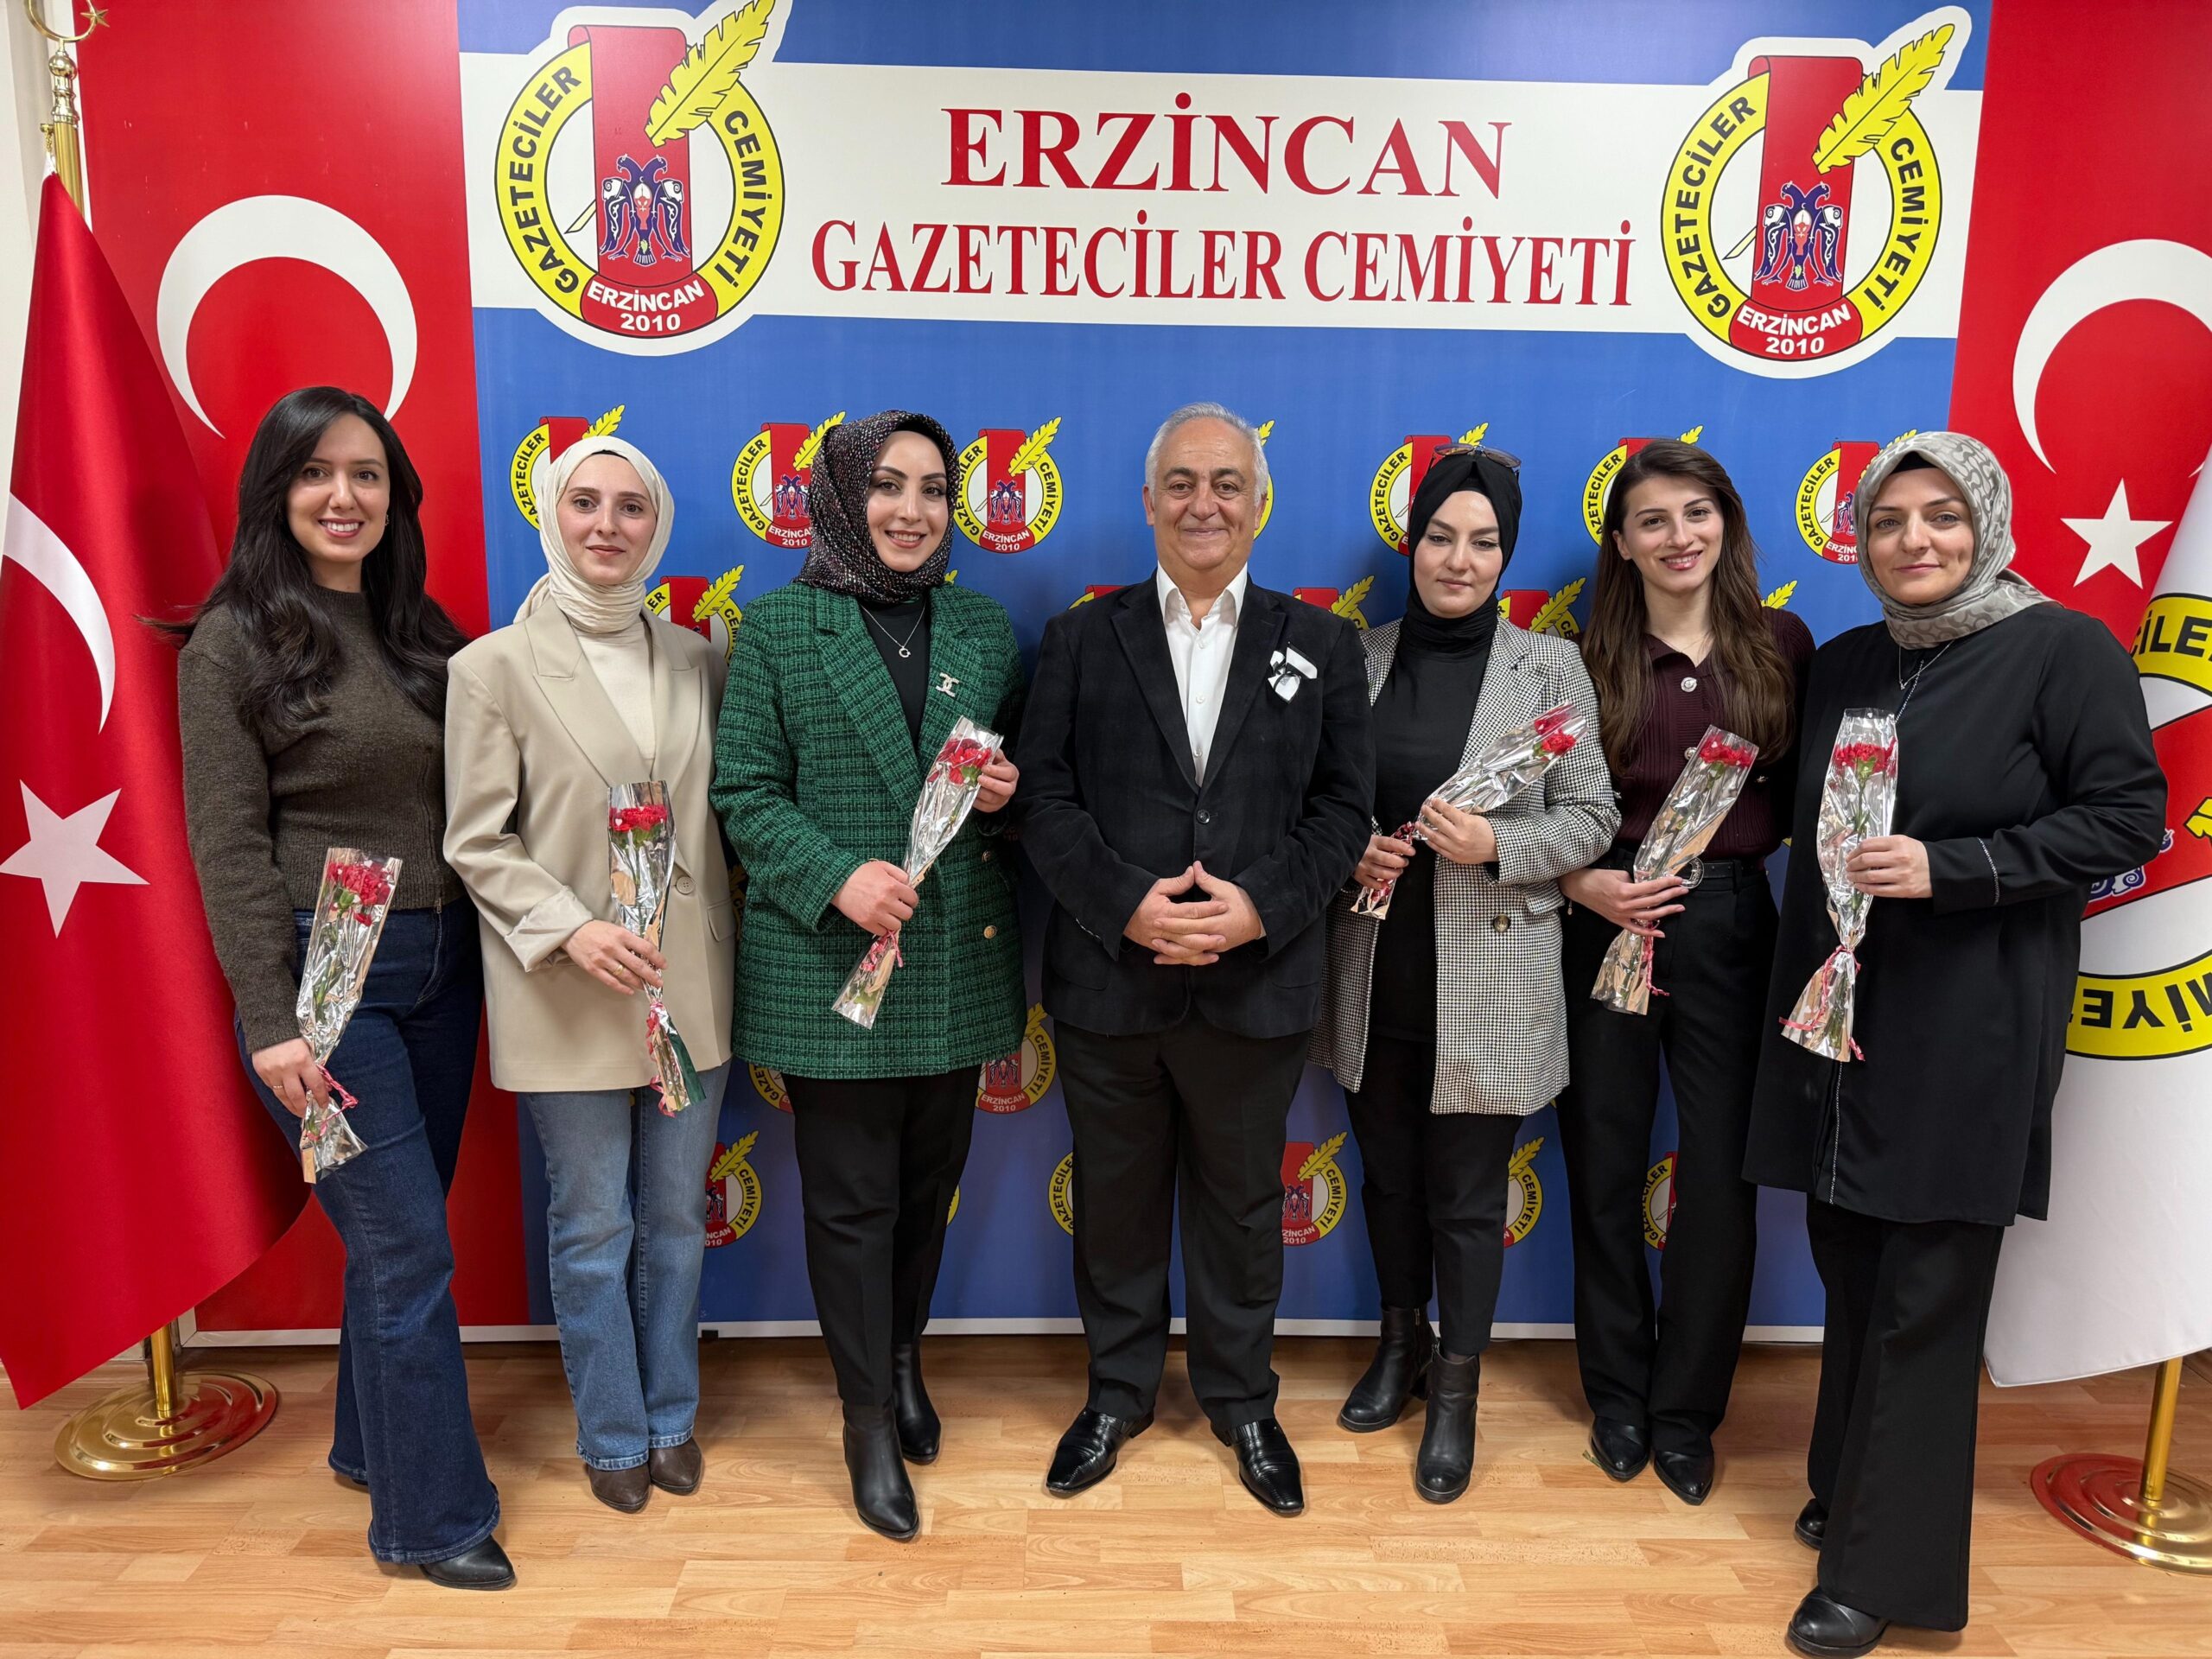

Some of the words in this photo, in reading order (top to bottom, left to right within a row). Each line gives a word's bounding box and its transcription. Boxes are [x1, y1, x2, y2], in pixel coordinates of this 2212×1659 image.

[941, 92, 1512, 200] ERZİNCAN
[510, 66, 582, 294] GAZETECİLER
[714, 110, 772, 288] CEMİYETİ
[1675, 96, 1757, 318] GAZETECİLER
[1863, 137, 1929, 311] CEMİYETİ
[811, 209, 1286, 301] GAZETECİLER
[1304, 215, 1637, 308] CEMİYETİ
[587, 279, 705, 312] ERZİNCAN
[620, 313, 681, 332] 2010
[1736, 303, 1851, 336] ERZİNCAN
[1765, 336, 1825, 355] 2010
[737, 439, 766, 531] GAZETECİLER
[1034, 461, 1058, 533] CEMİYETİ
[1375, 451, 1408, 542] GAZETECİLER
[1588, 454, 1622, 535] ZETECİLER
[1801, 457, 1835, 547] GAZETECİLER
[769, 526, 812, 538] ERZİNCA
[782, 537, 807, 546] 2010
[982, 529, 1030, 543] ERZİNCAN
[995, 543, 1020, 551] 2010
[1826, 541, 1857, 554] ERZİN
[1030, 1034, 1052, 1096] CEMİYETİ
[981, 1093, 1025, 1105] ERZİNCAN
[735, 1168, 758, 1230] CEMİYETİ
[1319, 1169, 1343, 1229] CEMİYETİ
[1514, 1174, 1538, 1234] CEMİYETİ
[1282, 1226, 1315, 1236] ZİNCAN
